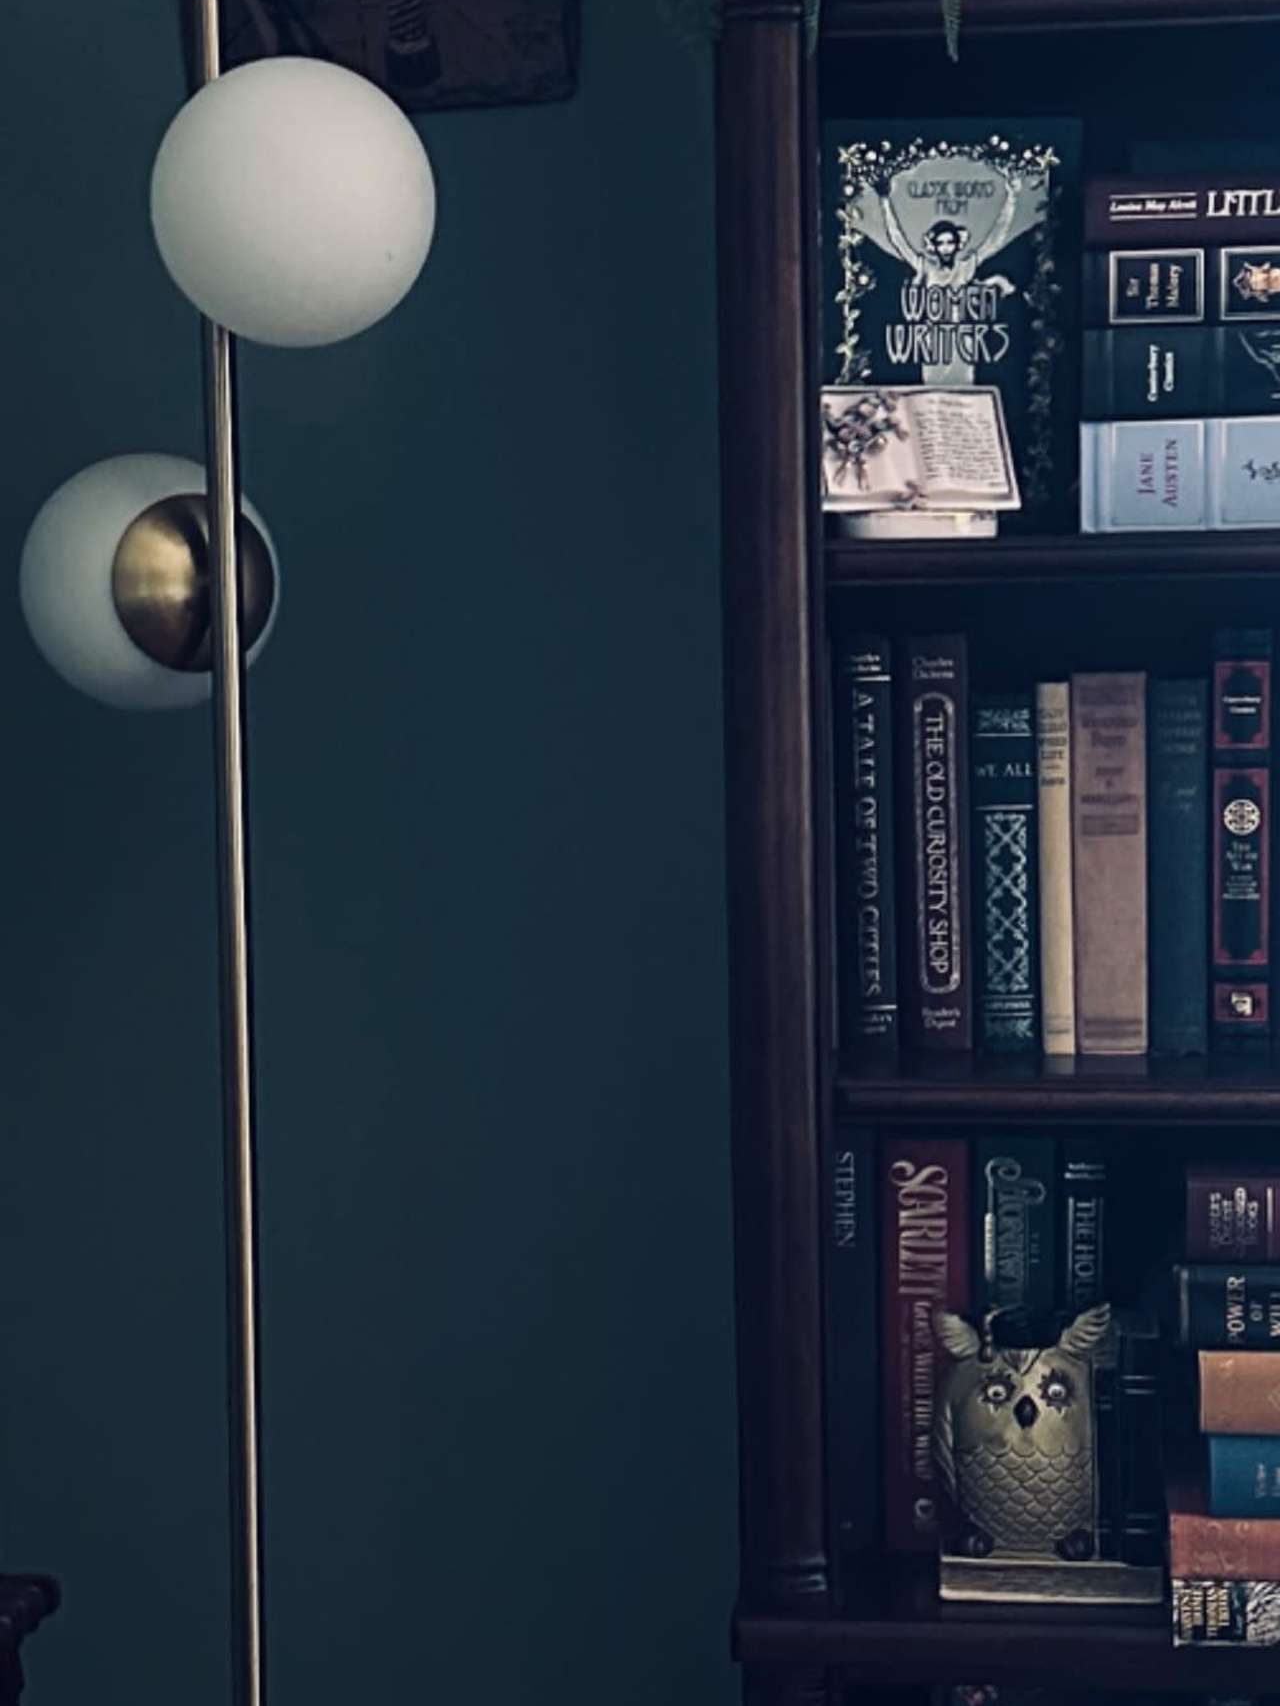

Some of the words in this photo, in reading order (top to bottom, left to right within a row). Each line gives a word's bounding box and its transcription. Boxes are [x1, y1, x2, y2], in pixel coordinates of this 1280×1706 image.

[900, 281, 997, 321] WOMEN
[1165, 263, 1185, 309] Malory
[885, 322, 1010, 364] WRITERS
[1137, 451, 1157, 496] JANE
[1162, 437, 1179, 508] AUSTEN
[852, 691, 874, 710] A
[852, 713, 877, 788] TALE
[922, 714, 945, 755] THE
[923, 756, 946, 804] OLD
[856, 796, 879, 832] OF
[924, 804, 949, 914] CURIOSITY
[858, 906, 883, 998] CITIES
[926, 917, 950, 975] SHOP
[832, 1150, 857, 1250] STEPHEN
[1072, 1198, 1097, 1240] THE
[887, 1158, 949, 1300] SCARLETT
[1226, 1274, 1246, 1345] POWER
